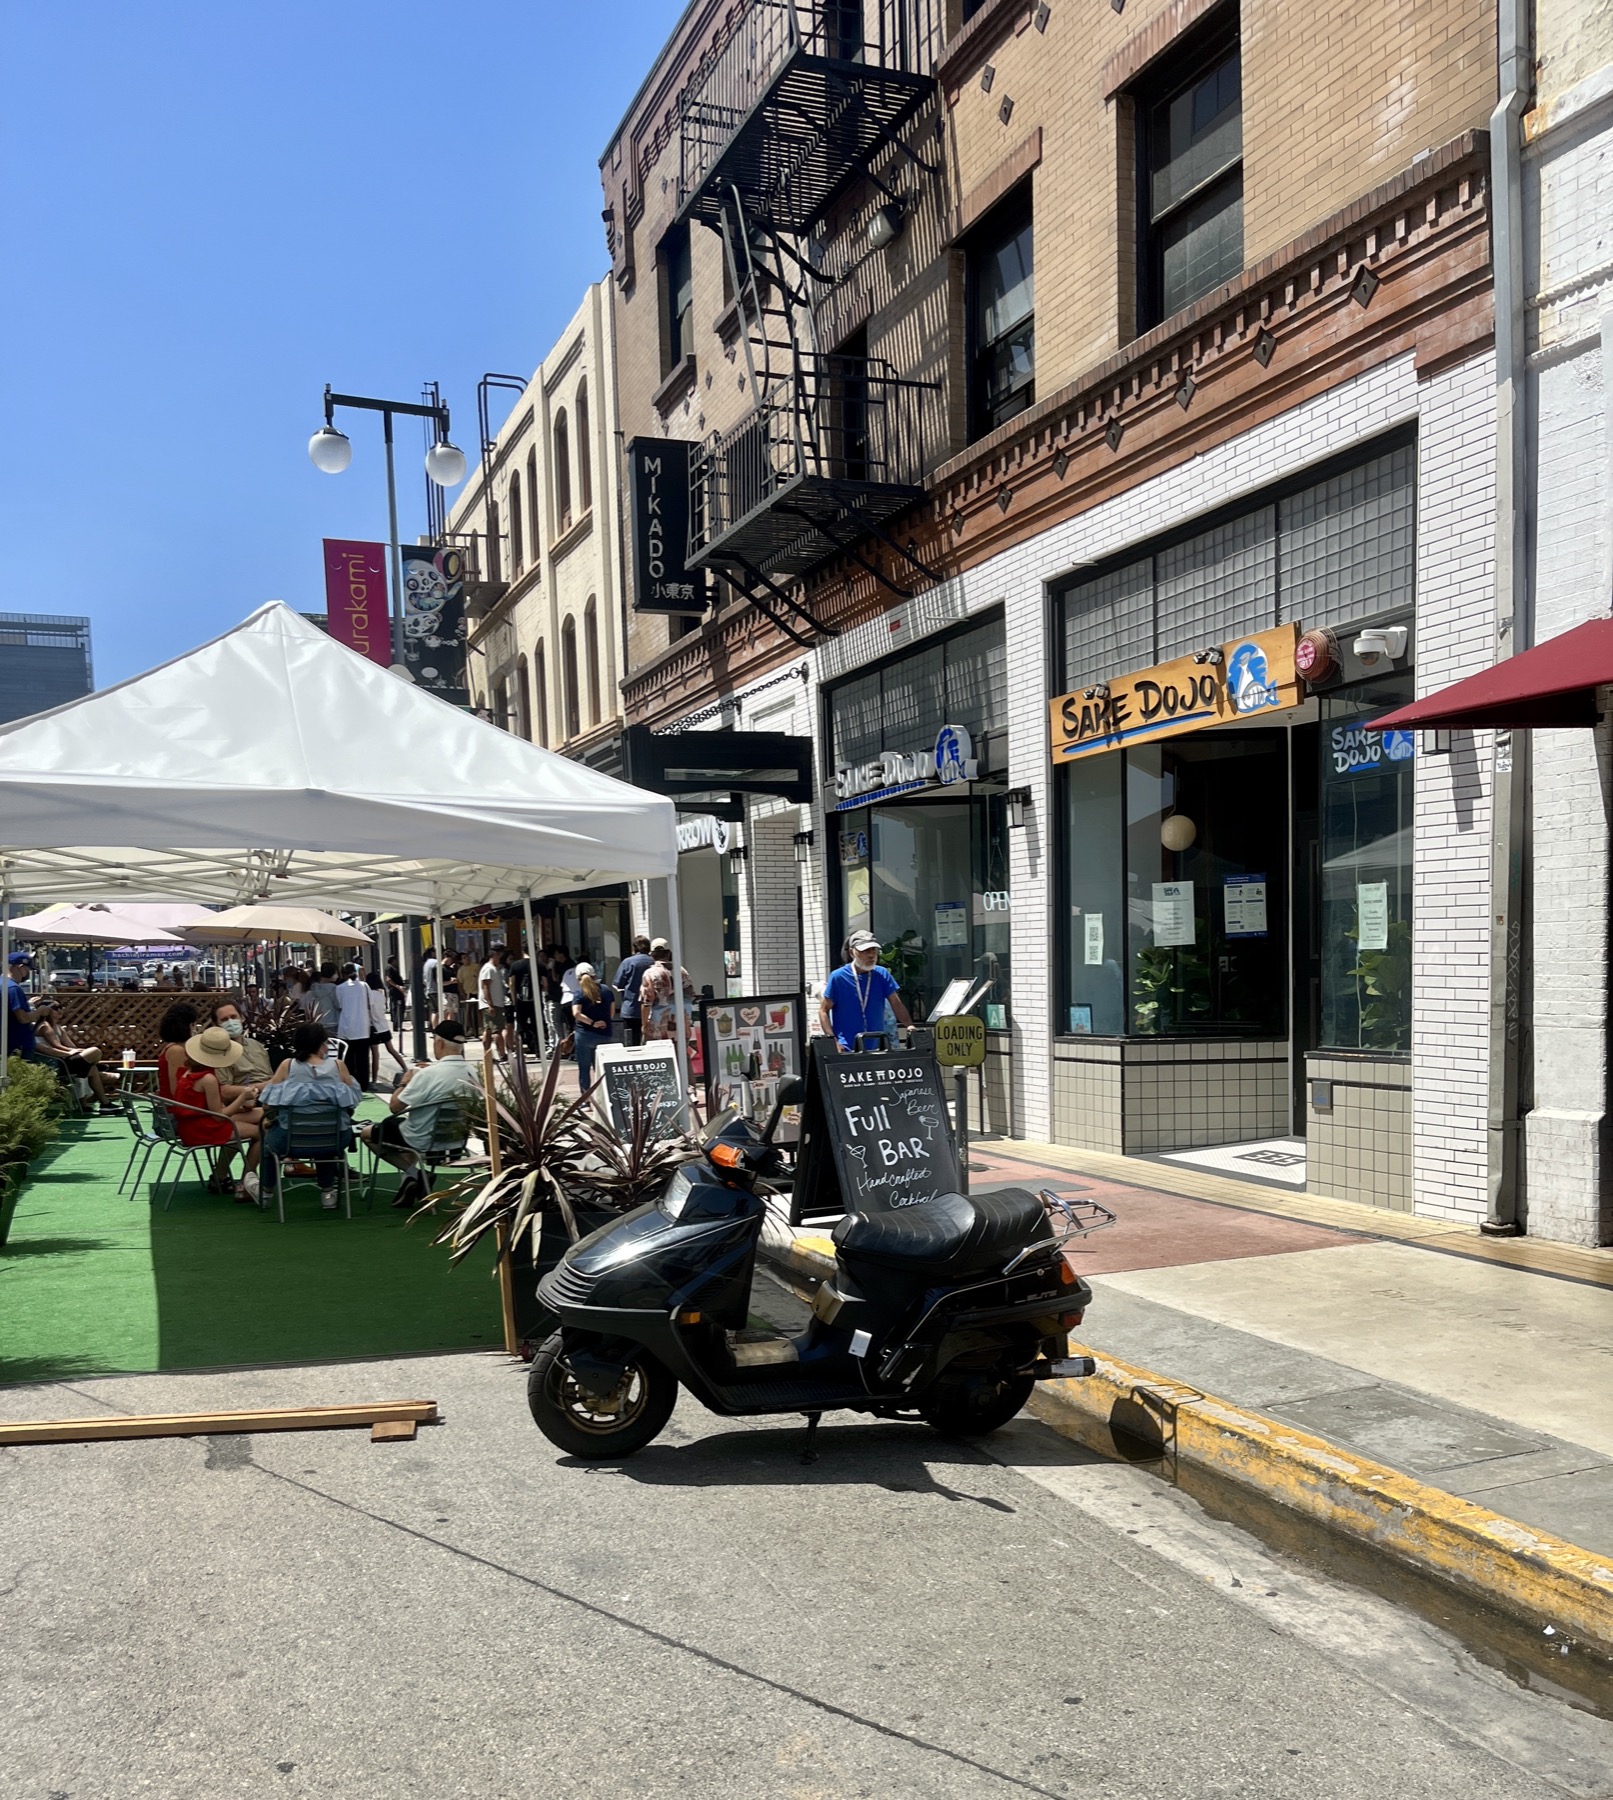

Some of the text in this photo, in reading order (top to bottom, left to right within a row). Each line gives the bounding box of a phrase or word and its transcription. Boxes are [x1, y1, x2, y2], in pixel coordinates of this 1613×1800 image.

[644, 456, 665, 579] MIKADO
[651, 582, 695, 600] 小東京
[1061, 674, 1217, 740] SAKE DOJO
[1331, 726, 1382, 751] SAKE
[1332, 745, 1381, 774] DOJO
[990, 1010, 1000, 1026] A
[937, 1025, 983, 1040] LOADING
[946, 1042, 973, 1057] ONLY
[611, 1064, 635, 1073] SAKE
[643, 1061, 667, 1071] DOJO
[840, 1071, 874, 1084] SAKE
[888, 1067, 923, 1080] DOJO
[888, 1086, 935, 1107] Japanese
[907, 1099, 939, 1116] Beer
[844, 1104, 892, 1136] Full
[878, 1137, 931, 1166] BAR
[1243, 1151, 1305, 1165] 335
